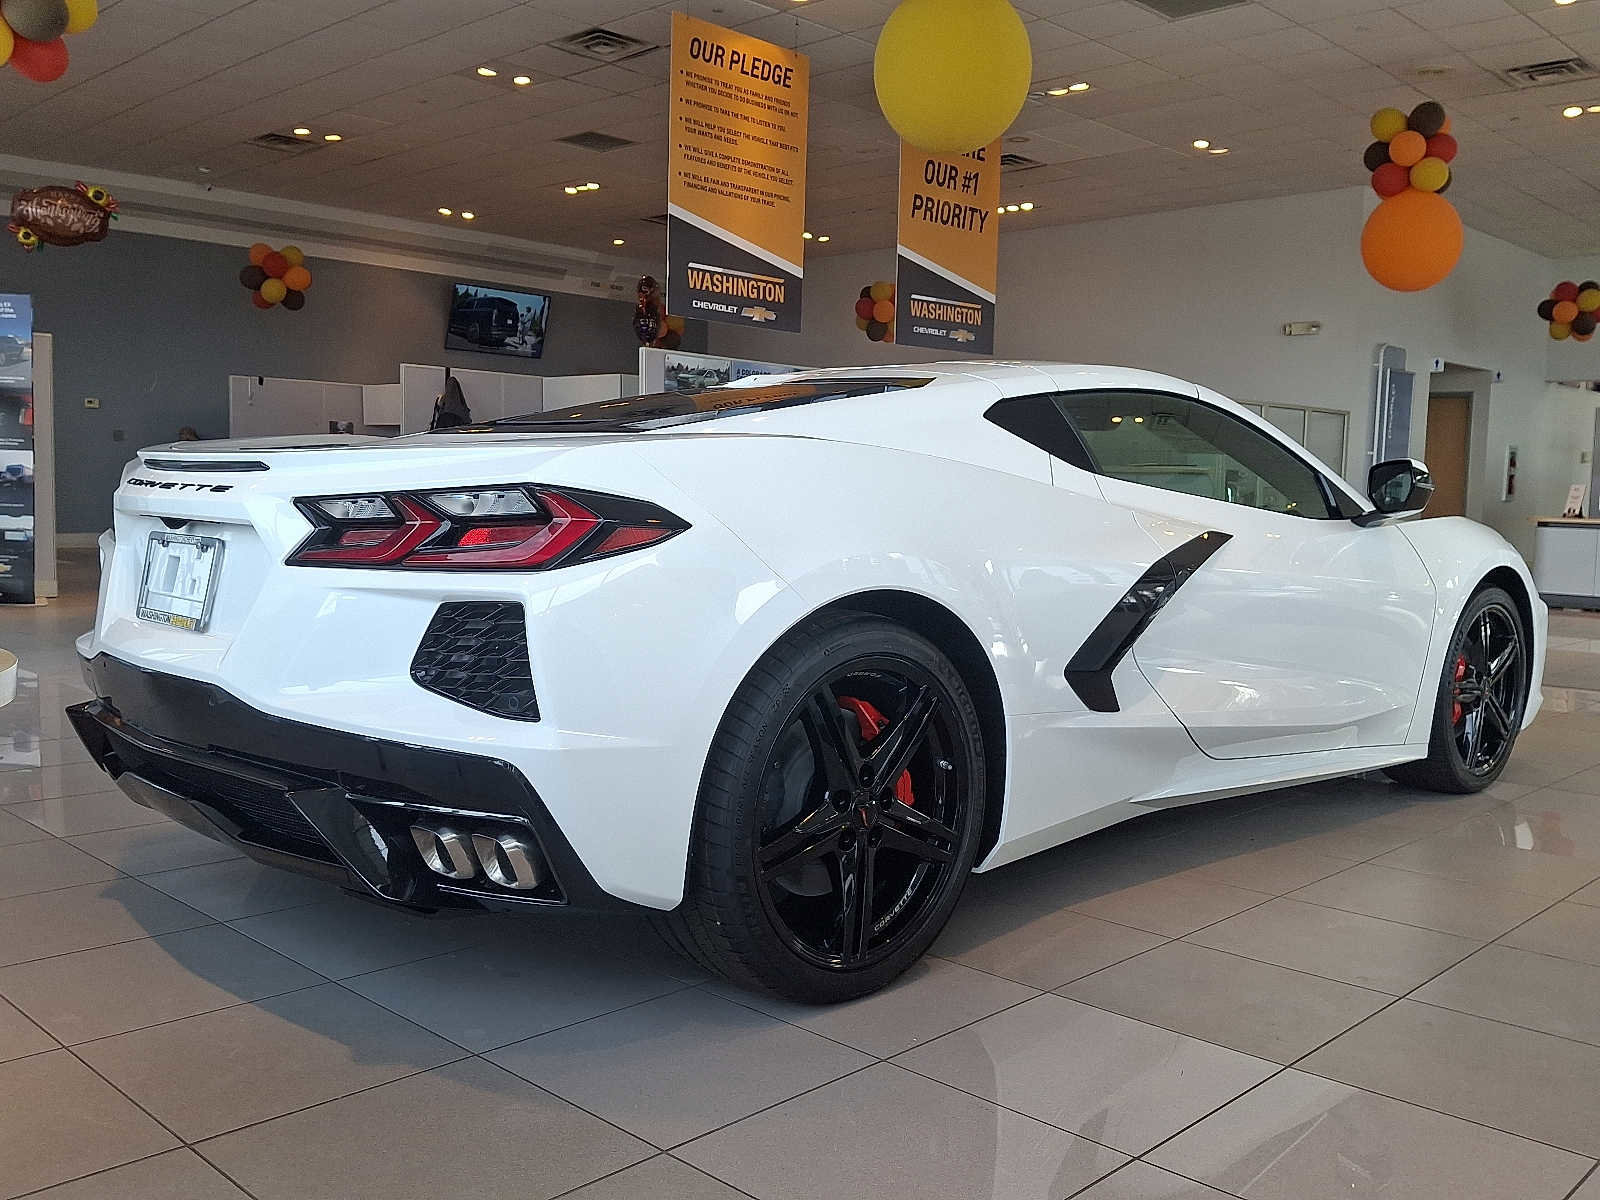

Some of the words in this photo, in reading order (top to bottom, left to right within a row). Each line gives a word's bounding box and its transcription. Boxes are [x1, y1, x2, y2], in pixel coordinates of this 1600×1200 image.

[689, 37, 726, 68] OUR
[729, 50, 794, 89] PLEDGE
[719, 80, 733, 90] TREAT
[749, 89, 763, 98] FAMILY
[726, 127, 741, 137] SELECT
[691, 146, 703, 154] WILL
[718, 152, 740, 163] COMPLETE
[924, 159, 959, 191] OUR
[961, 170, 980, 196] #1
[911, 193, 990, 233] PRIORITY
[687, 268, 785, 304] WASHINGTON
[692, 300, 738, 314] CHEVROLET
[910, 301, 982, 326] WASHINGTON
[913, 326, 947, 336] CHEVROLET
[127, 478, 234, 493] CORVETTE
[873, 887, 913, 932] CORVETTE
